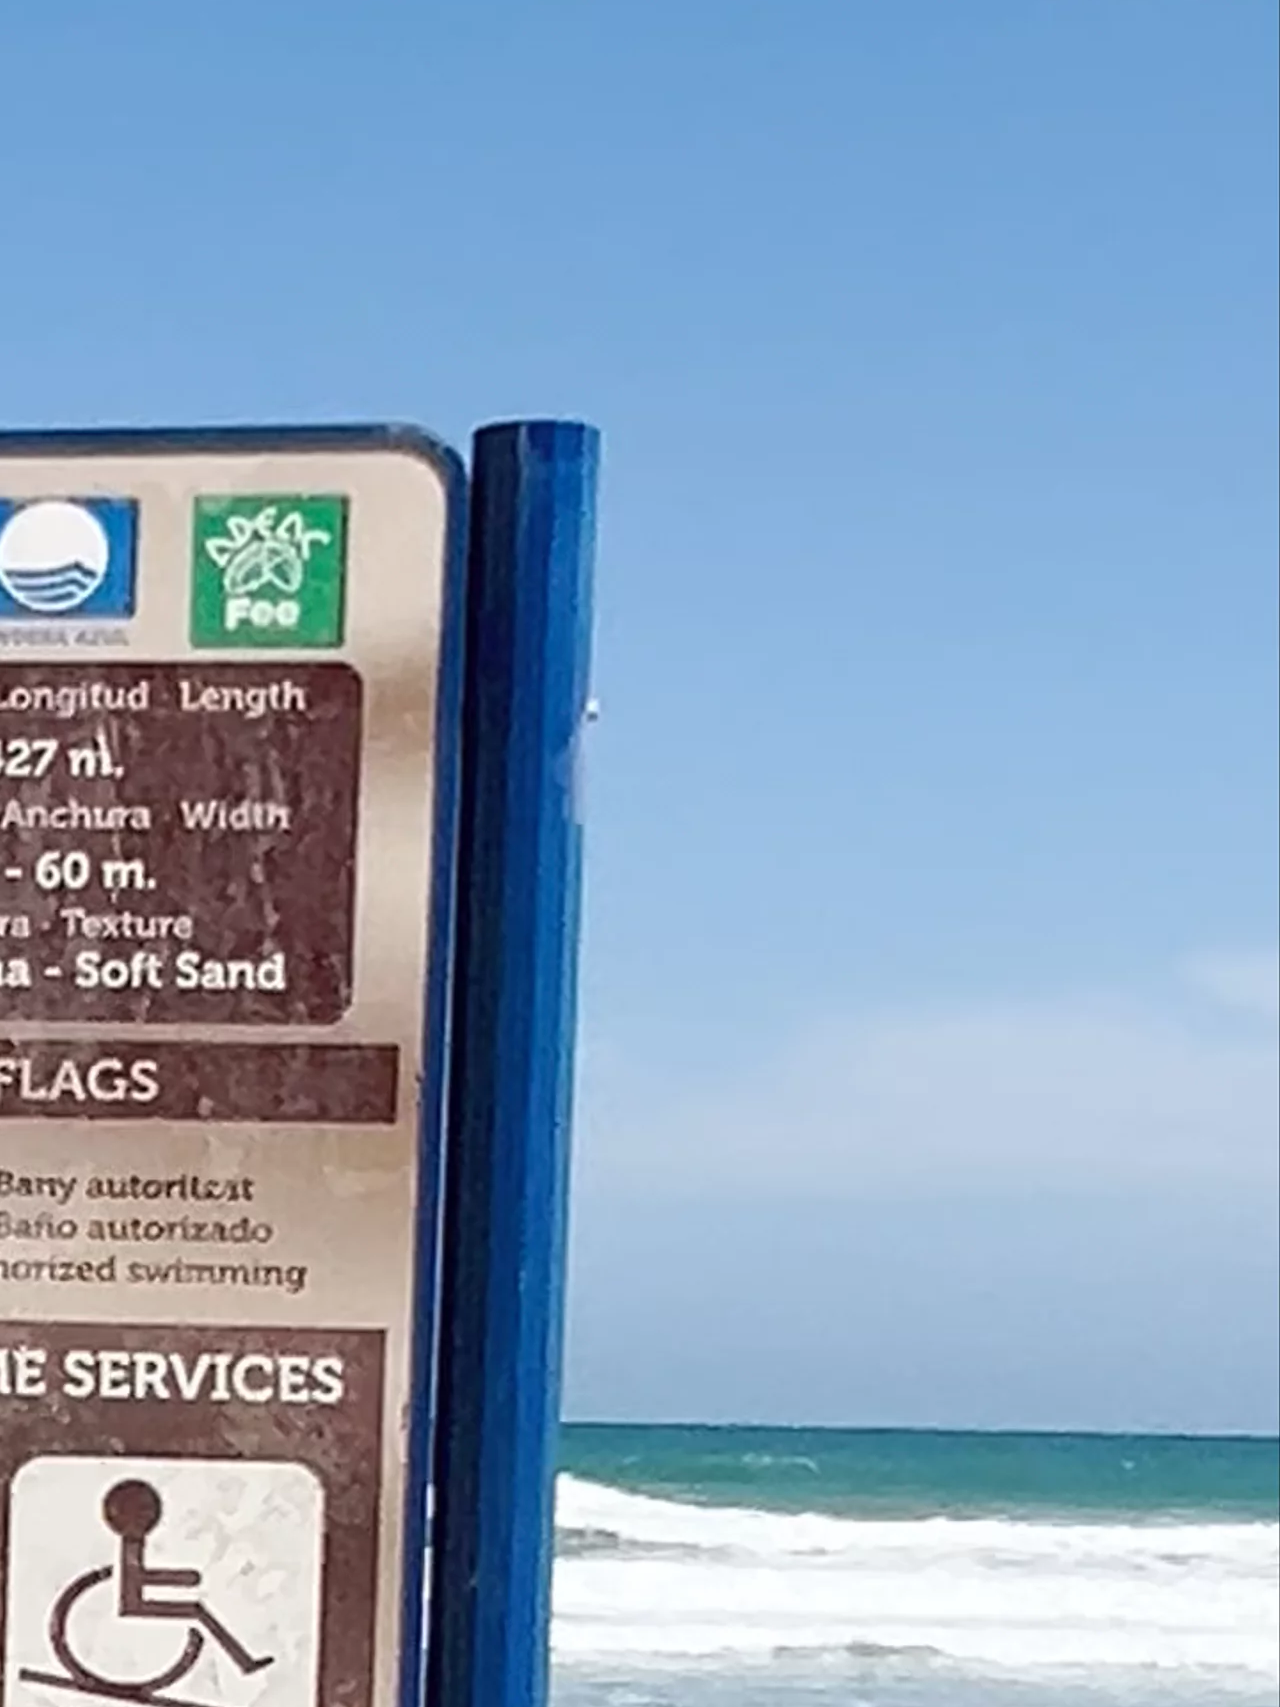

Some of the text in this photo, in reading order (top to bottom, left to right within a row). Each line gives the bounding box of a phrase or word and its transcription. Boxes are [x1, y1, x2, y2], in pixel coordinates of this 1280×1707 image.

[181, 681, 306, 716] Length
[0, 801, 150, 829] Anchura
[181, 801, 290, 829] Width
[36, 853, 88, 887] 60
[103, 861, 155, 889] m.
[61, 909, 193, 939] Texture
[76, 951, 166, 988] Soft
[176, 953, 285, 989] Sand
[87, 1215, 273, 1244] autorizado
[125, 1258, 307, 1293] swimming
[64, 1352, 344, 1405] SERVICES
